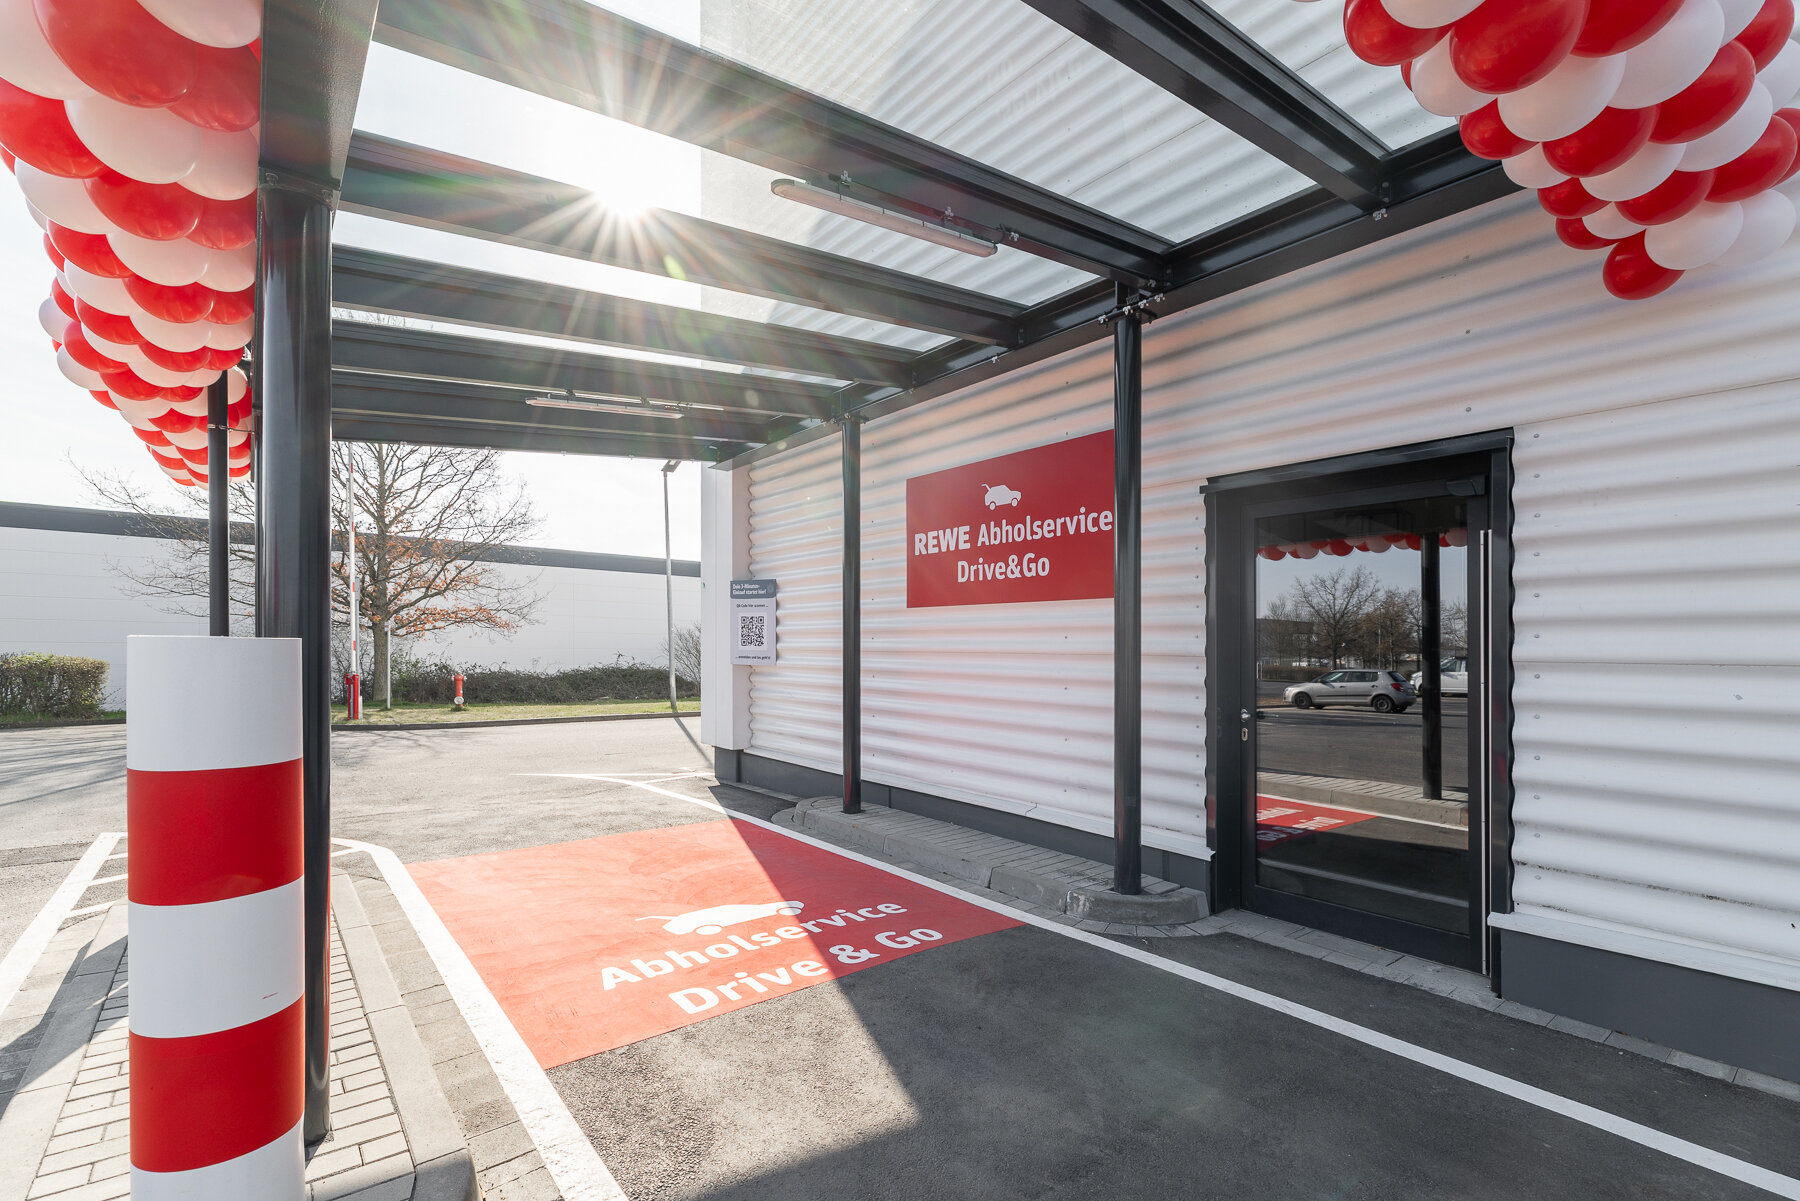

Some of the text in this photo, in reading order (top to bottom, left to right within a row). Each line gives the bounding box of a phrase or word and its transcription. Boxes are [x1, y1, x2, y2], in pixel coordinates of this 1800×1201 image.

[914, 507, 1113, 555] REWE Abholservice
[957, 553, 1050, 583] Drive&Go
[600, 902, 907, 990] Abholservice
[668, 928, 943, 1015] Drive & Go
